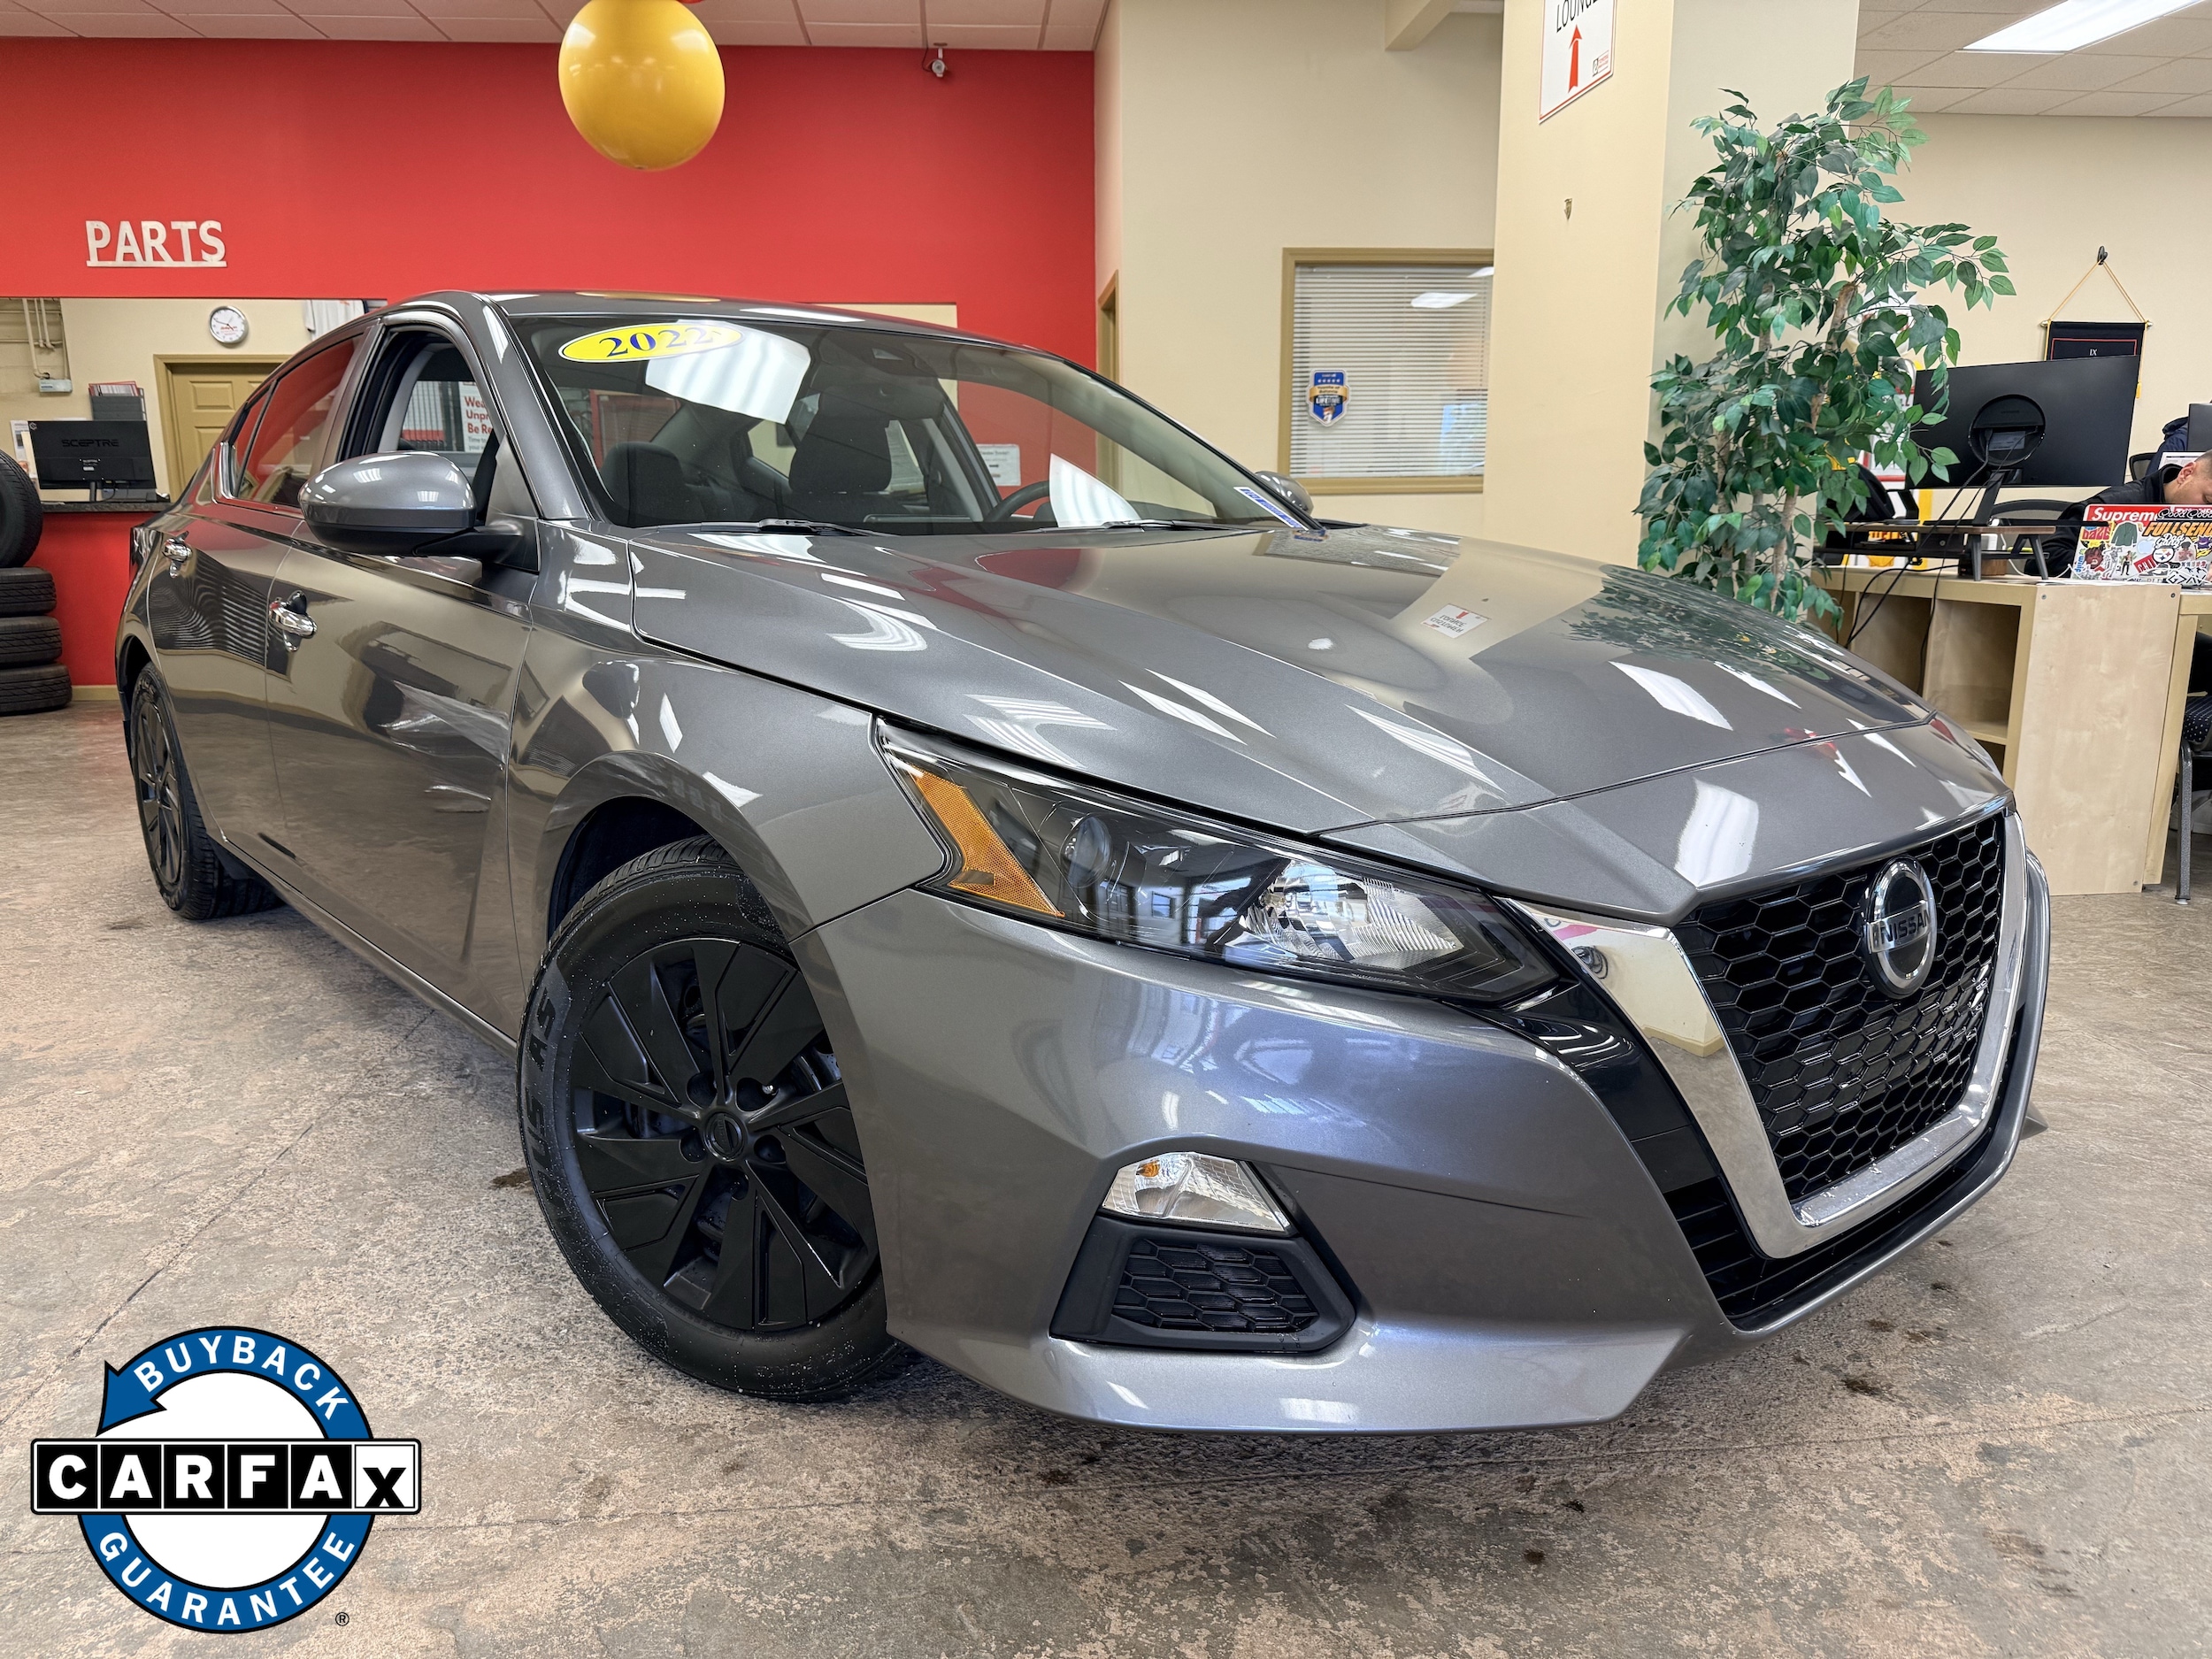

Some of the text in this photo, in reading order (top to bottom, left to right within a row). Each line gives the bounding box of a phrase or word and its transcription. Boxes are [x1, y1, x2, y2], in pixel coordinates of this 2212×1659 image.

[1556, 0, 1598, 33] LOUN
[86, 219, 227, 266] PARTS
[599, 326, 714, 357] 2022
[61, 439, 119, 448] SCEPTRE
[468, 423, 480, 434] Be
[2092, 507, 2159, 521] Suprem
[1880, 910, 1931, 944] NISSAN
[529, 987, 557, 1072] AS
